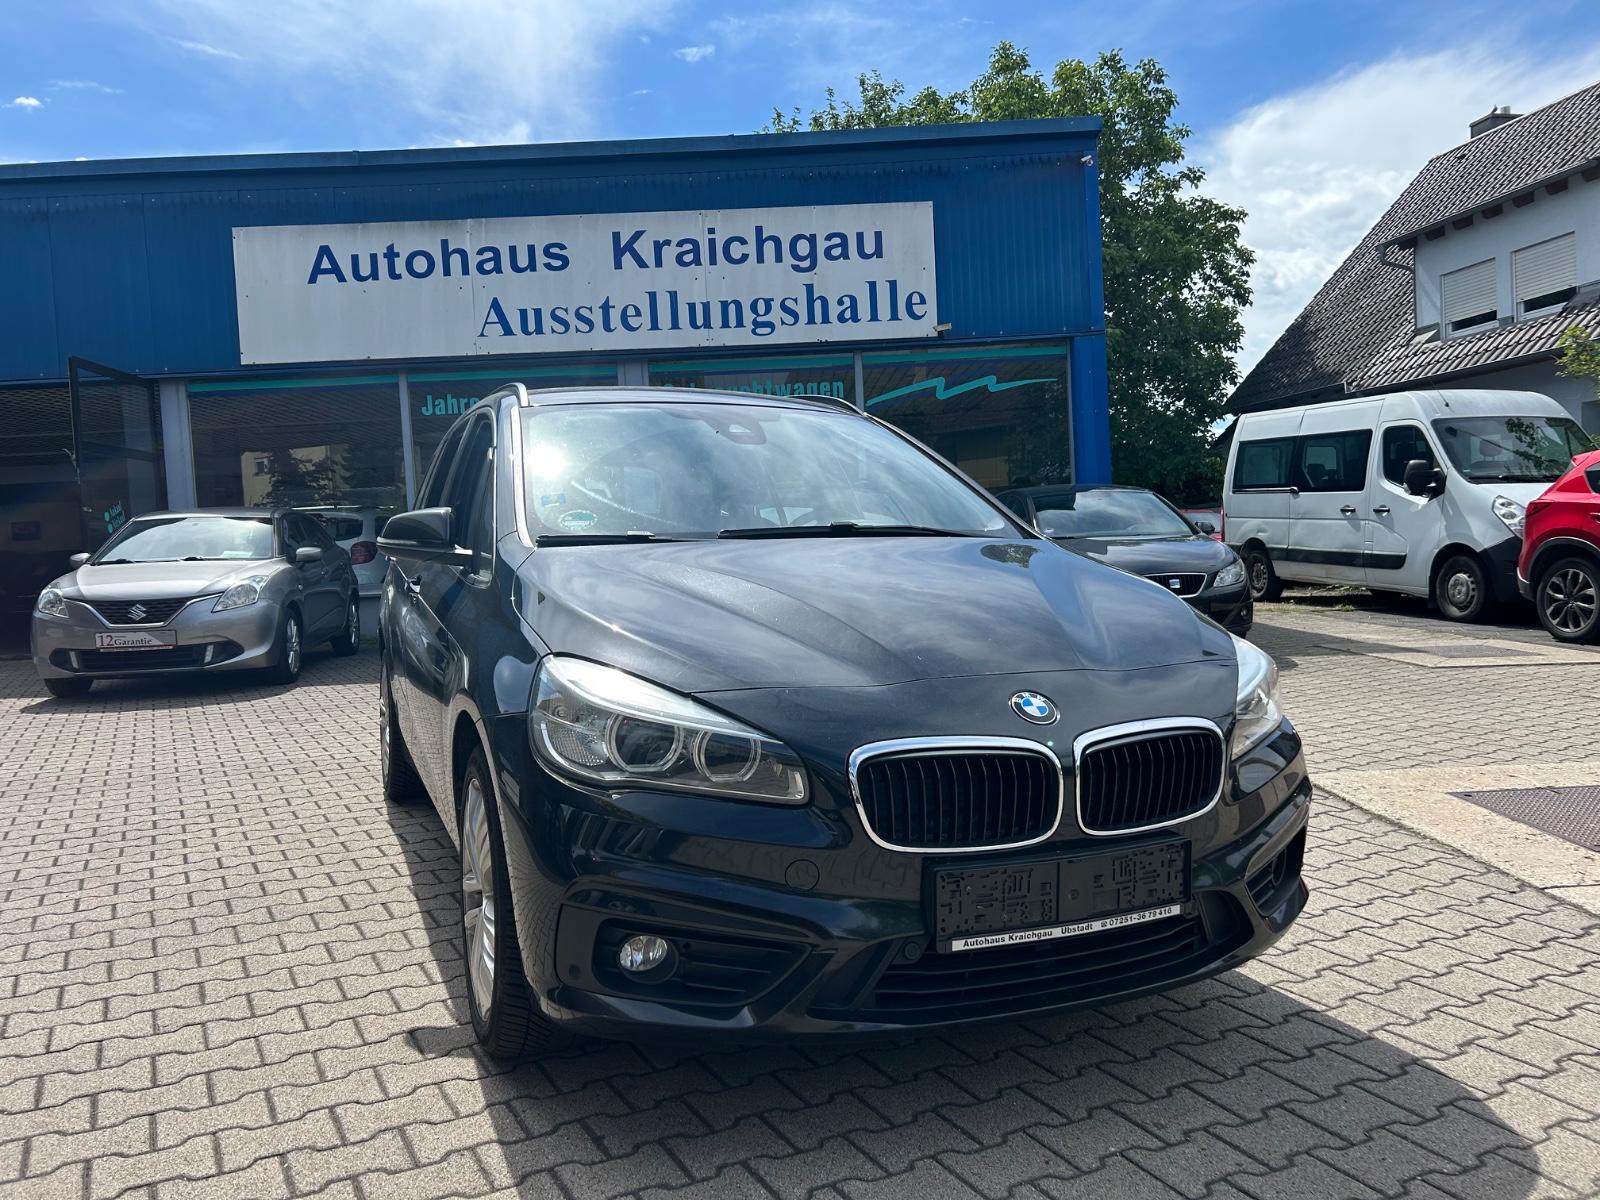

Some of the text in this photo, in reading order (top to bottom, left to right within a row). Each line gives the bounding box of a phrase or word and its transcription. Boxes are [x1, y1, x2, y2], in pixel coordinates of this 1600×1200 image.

[307, 225, 884, 284] Autohaus Kraichgau
[477, 279, 928, 338] Ausstellungshalle
[97, 634, 153, 647] 12 Garantie
[963, 936, 1006, 948] Autohaus
[1008, 930, 1053, 941] Kraichgau
[1061, 923, 1093, 934] Ubstadt
